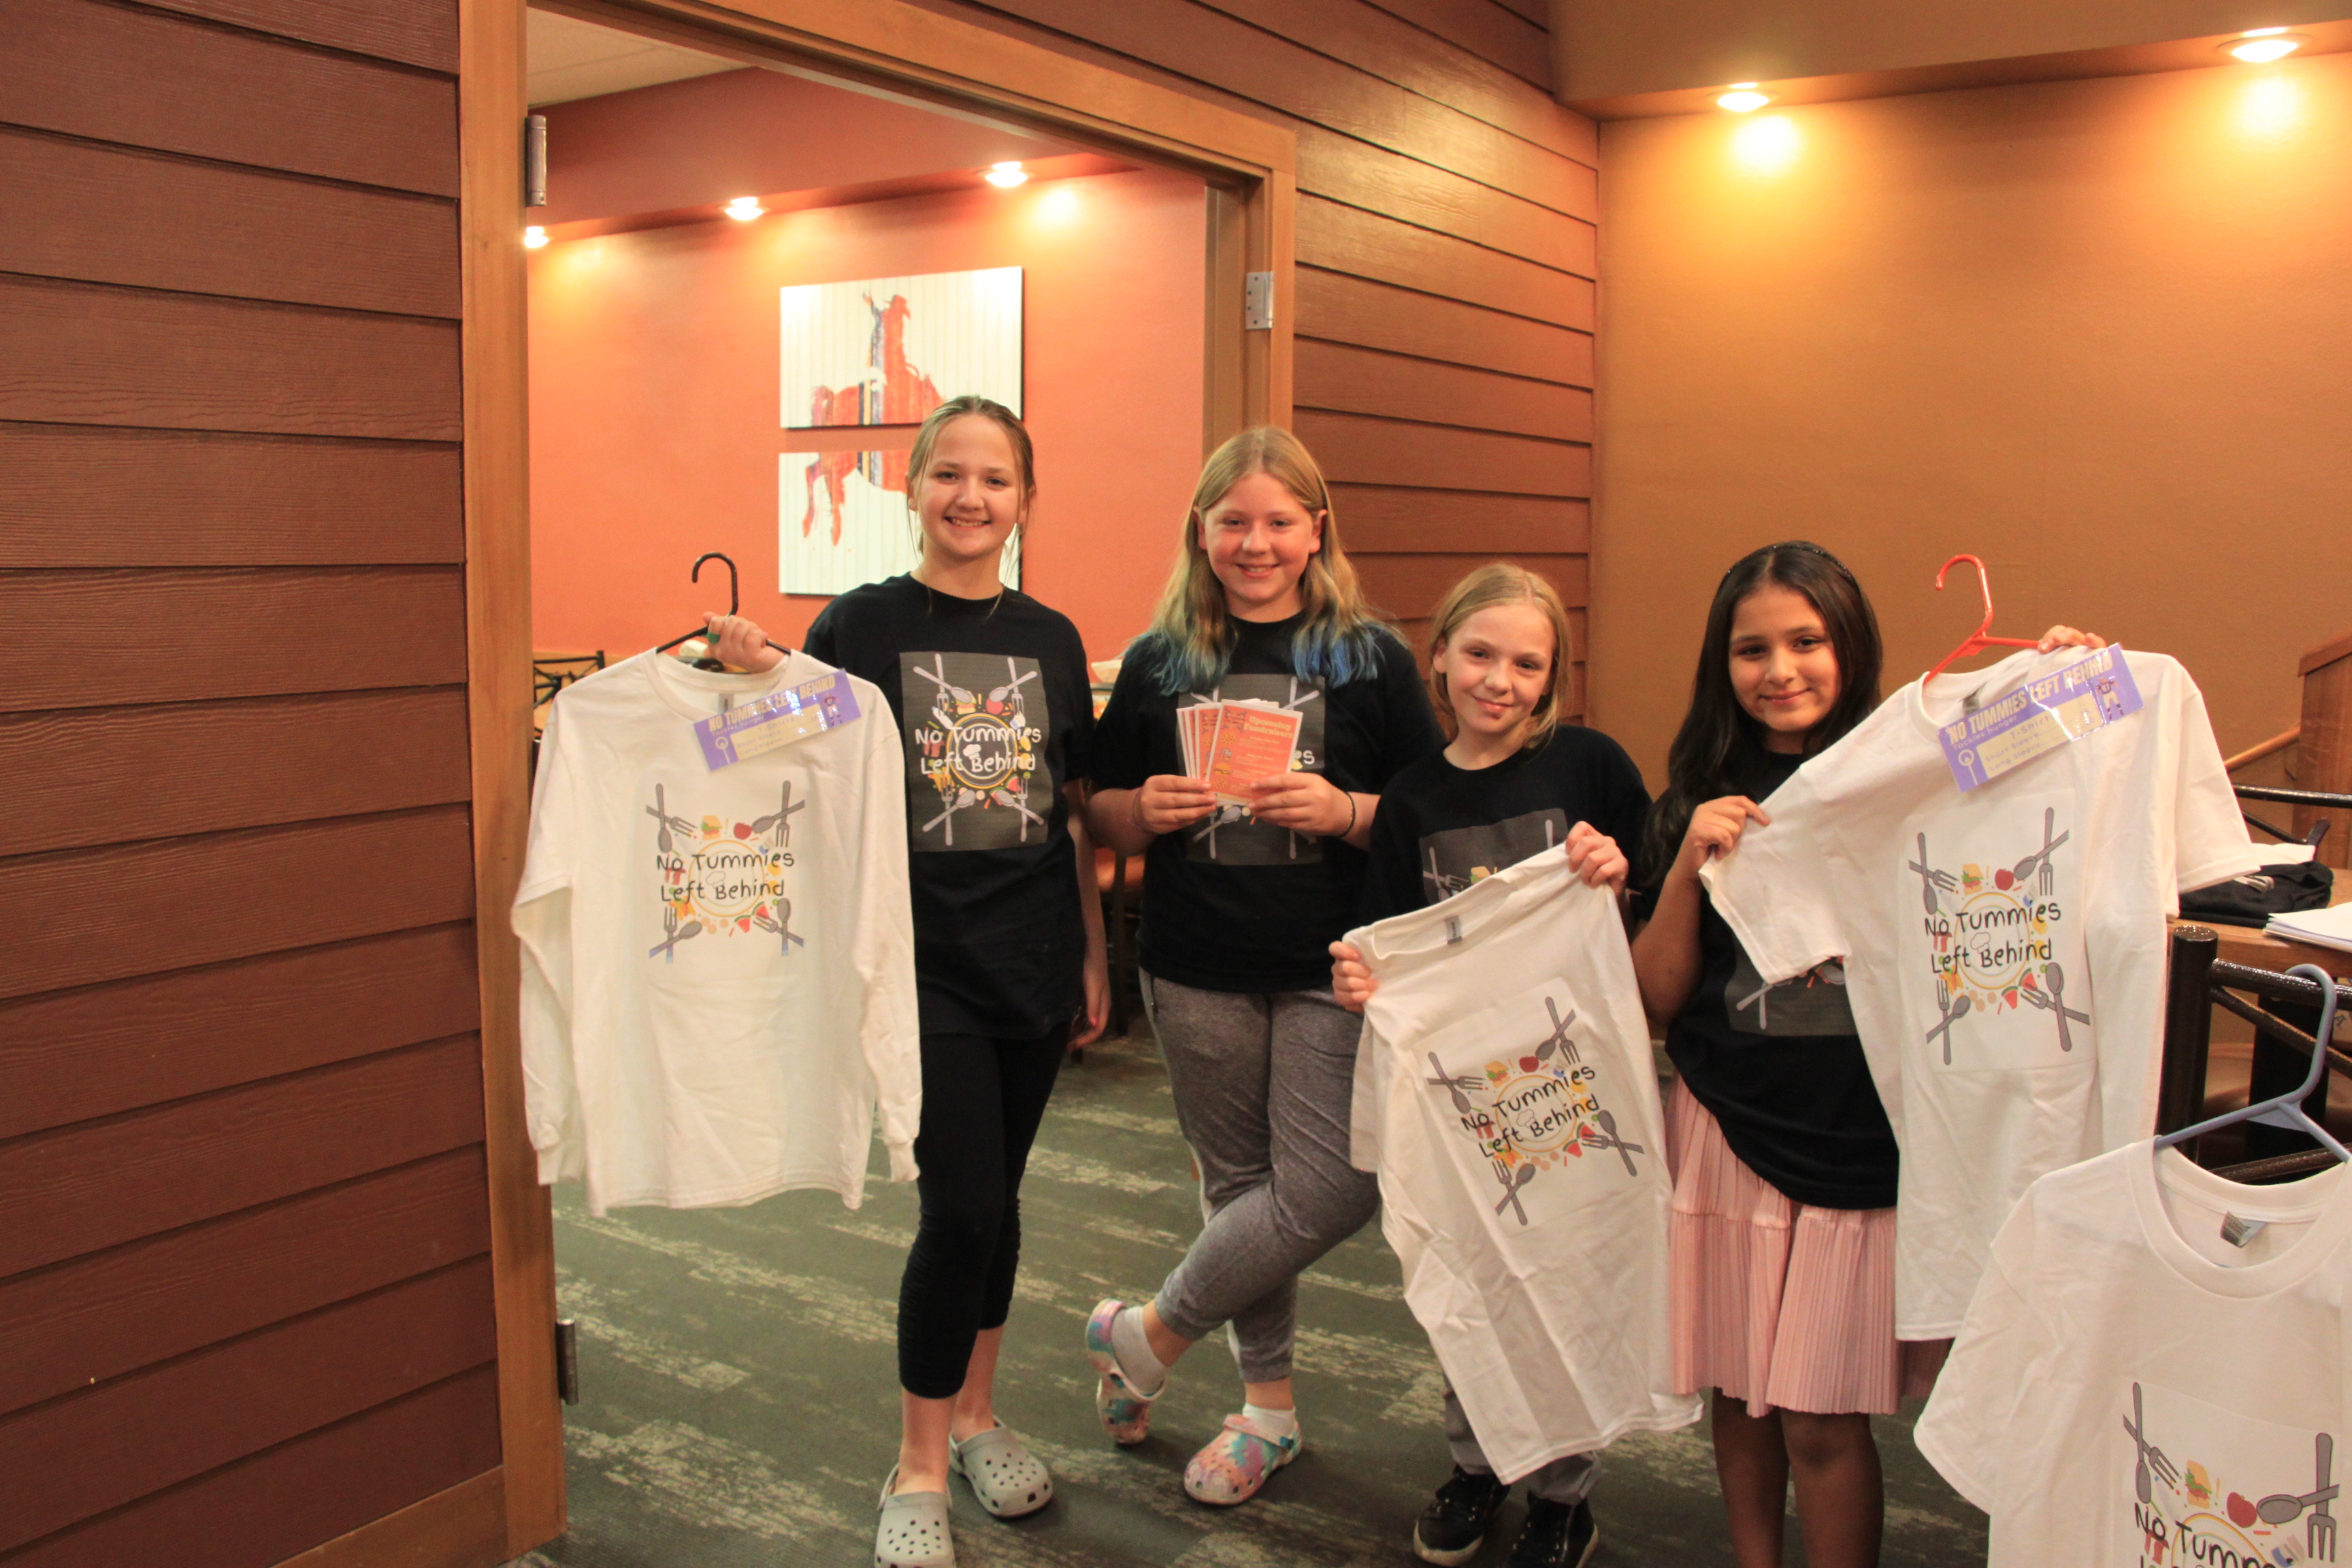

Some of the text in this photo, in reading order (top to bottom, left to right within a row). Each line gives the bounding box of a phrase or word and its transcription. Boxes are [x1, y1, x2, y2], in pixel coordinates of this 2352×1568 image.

[708, 715, 723, 732] NO
[724, 697, 774, 726] TUMMIES
[799, 674, 836, 700] BEHIND
[1948, 651, 2113, 745] NO TUMMIES LEFT BEHIND
[915, 726, 1042, 745] No Tummies
[1987, 715, 2016, 733] hunger
[921, 751, 1036, 775] Left Behind
[657, 849, 795, 872] No Tummies
[660, 881, 785, 903] Left Behind
[1925, 902, 2061, 937] No Tummies
[1931, 937, 2052, 974] Left Behind
[1460, 1064, 1596, 1132] No Tummies
[1478, 1094, 1599, 1158] Left Behind
[2134, 1502, 2166, 1541] No
